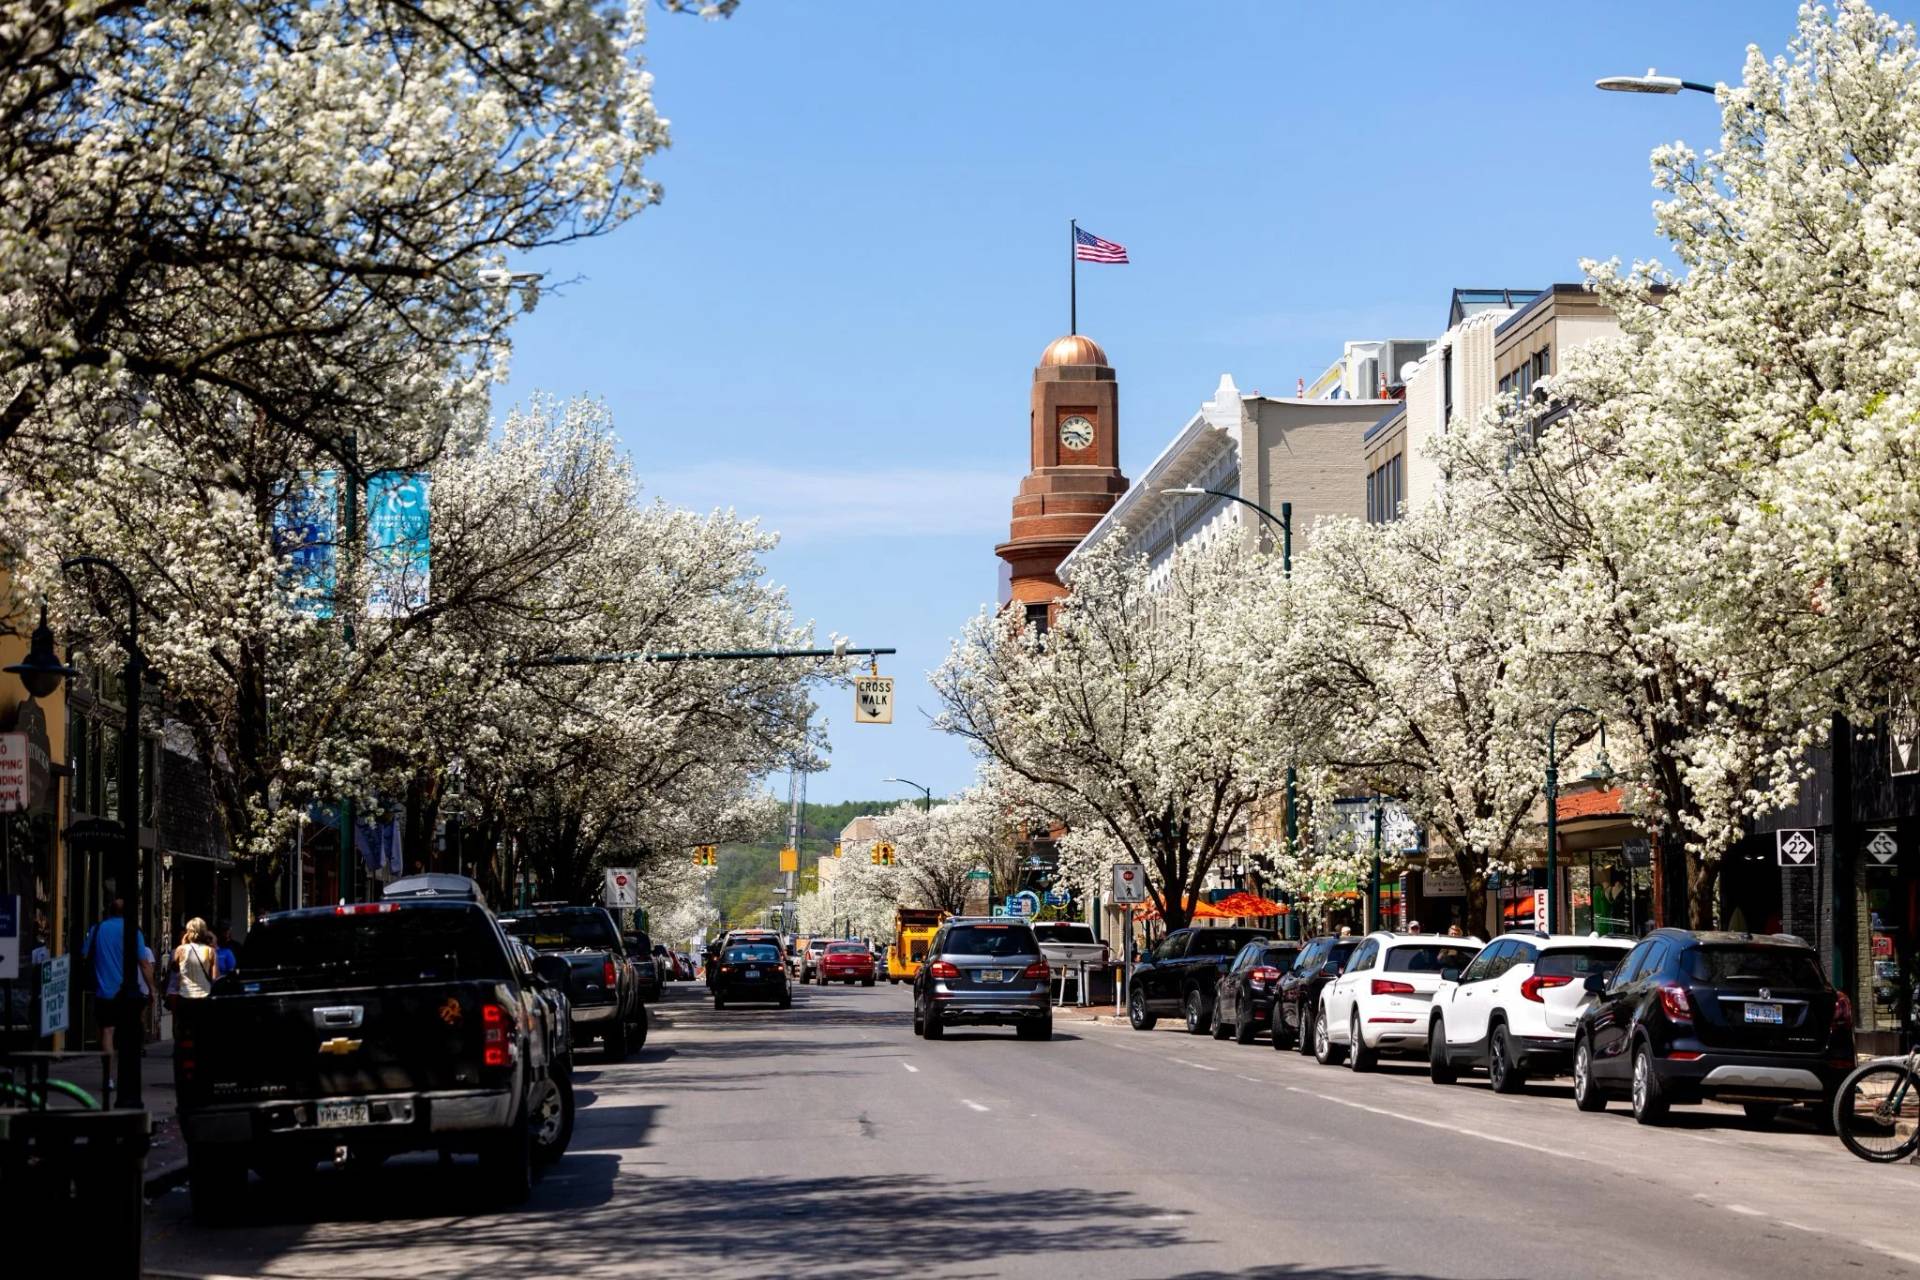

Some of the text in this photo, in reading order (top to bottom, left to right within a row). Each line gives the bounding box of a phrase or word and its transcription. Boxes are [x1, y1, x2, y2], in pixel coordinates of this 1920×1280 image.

[859, 681, 891, 693] CROSS
[861, 694, 887, 705] WALK
[1788, 841, 1807, 855] 22
[49, 1012, 61, 1028] ONLY
